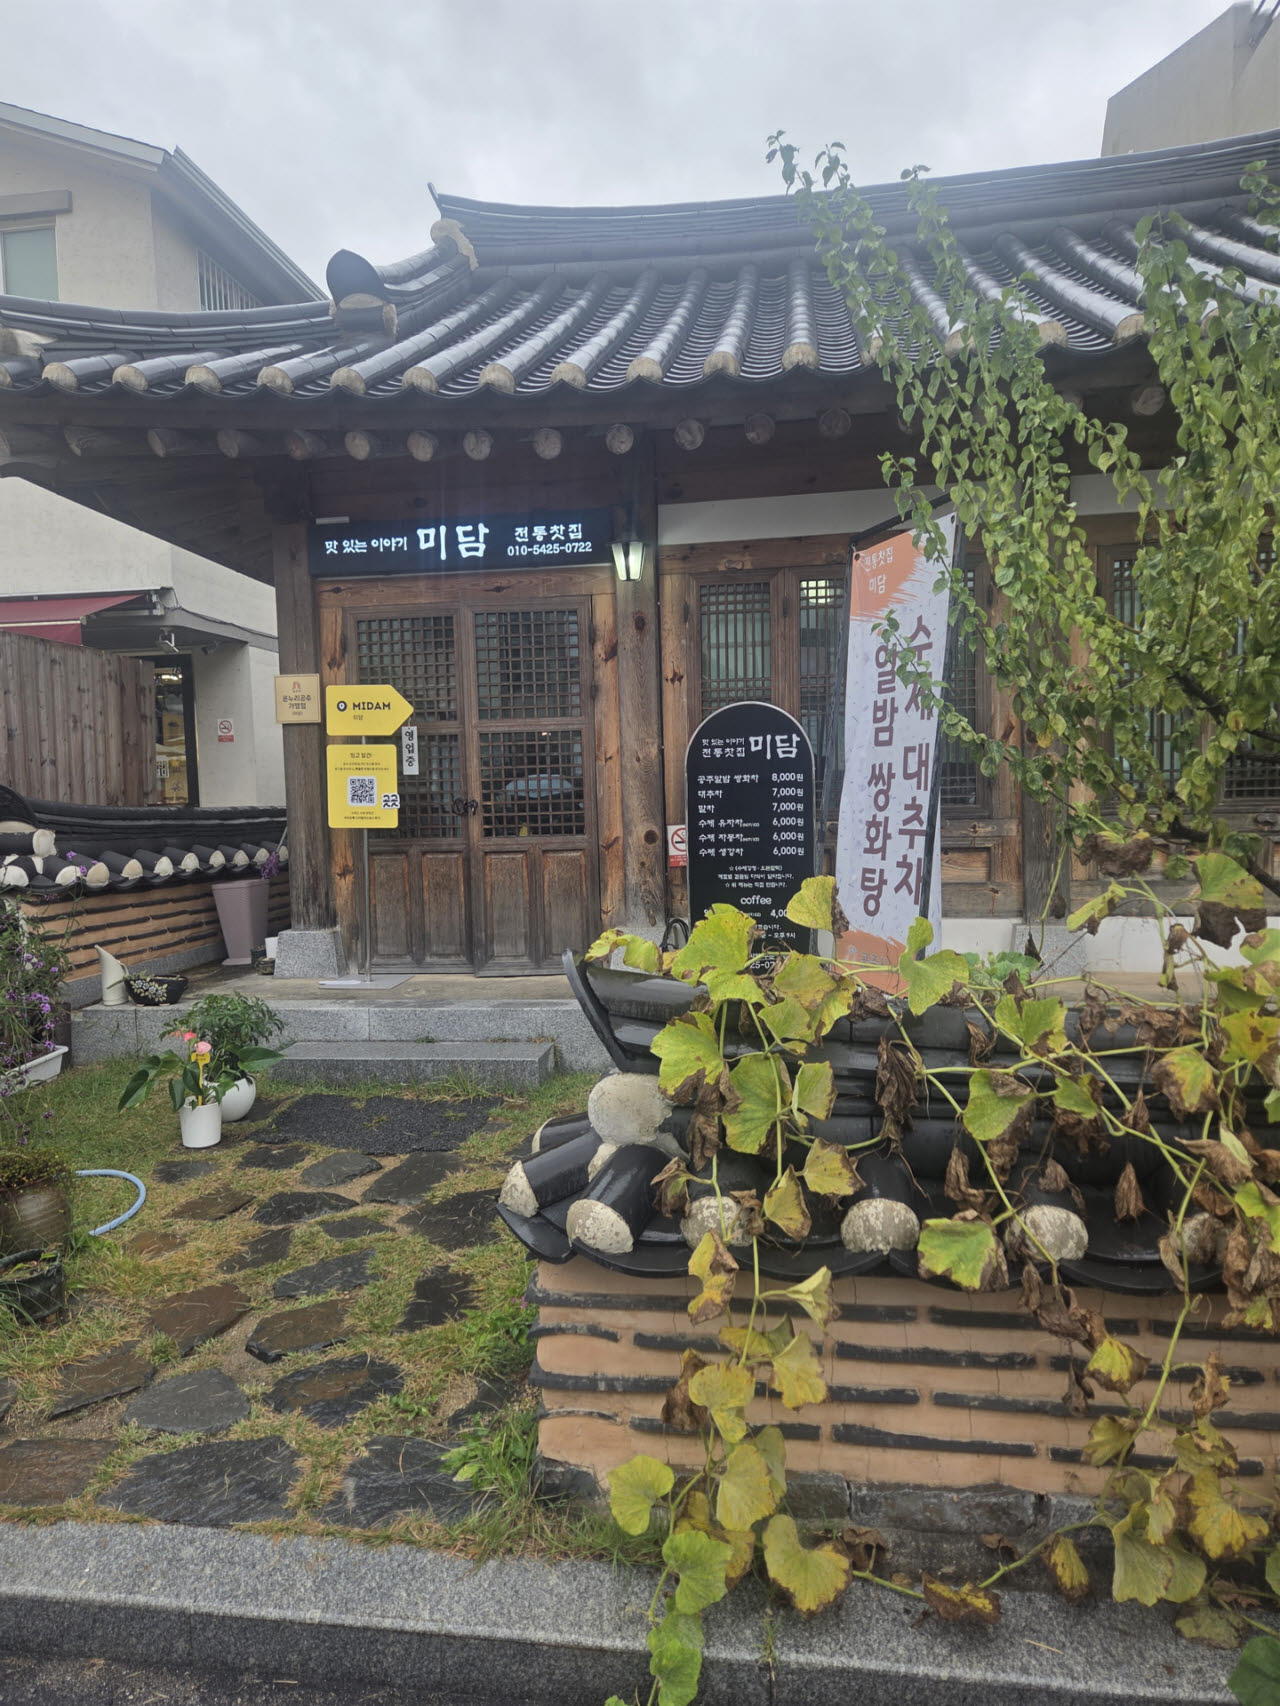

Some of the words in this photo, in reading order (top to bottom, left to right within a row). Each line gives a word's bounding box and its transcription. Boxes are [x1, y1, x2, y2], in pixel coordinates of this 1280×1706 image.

[514, 523, 582, 543] 전통찻집
[325, 540, 338, 554] 맛
[342, 540, 368, 553] 있는
[371, 537, 408, 552] 이야기
[416, 523, 489, 560] 미담
[507, 542, 592, 556] 010-5425-0722
[869, 574, 887, 594] 미담
[352, 701, 391, 711] MIDAM
[726, 738, 745, 746] 이야기
[749, 733, 801, 760] 미담
[405, 730, 416, 767] 영업중
[702, 747, 745, 758] 전통찻집
[697, 775, 730, 784] 공주알밤
[733, 774, 759, 783] 쌍화차
[772, 773, 804, 783] 8,000원
[697, 790, 723, 798] 대추차
[772, 788, 804, 797] 7,000원
[772, 802, 804, 812] 7,000원
[699, 819, 715, 828] 수제
[718, 819, 743, 828] 유자차
[772, 817, 804, 827] 6,000원
[894, 743, 930, 906] 대추차
[699, 834, 715, 842] 수제
[718, 833, 743, 842] 자몽차
[772, 832, 804, 842] 6,000원
[860, 762, 896, 917] 쌍화탕
[699, 848, 715, 857] 수제
[718, 848, 744, 856] 생강차
[772, 847, 805, 856] 6,000원
[740, 895, 772, 905] coffee
